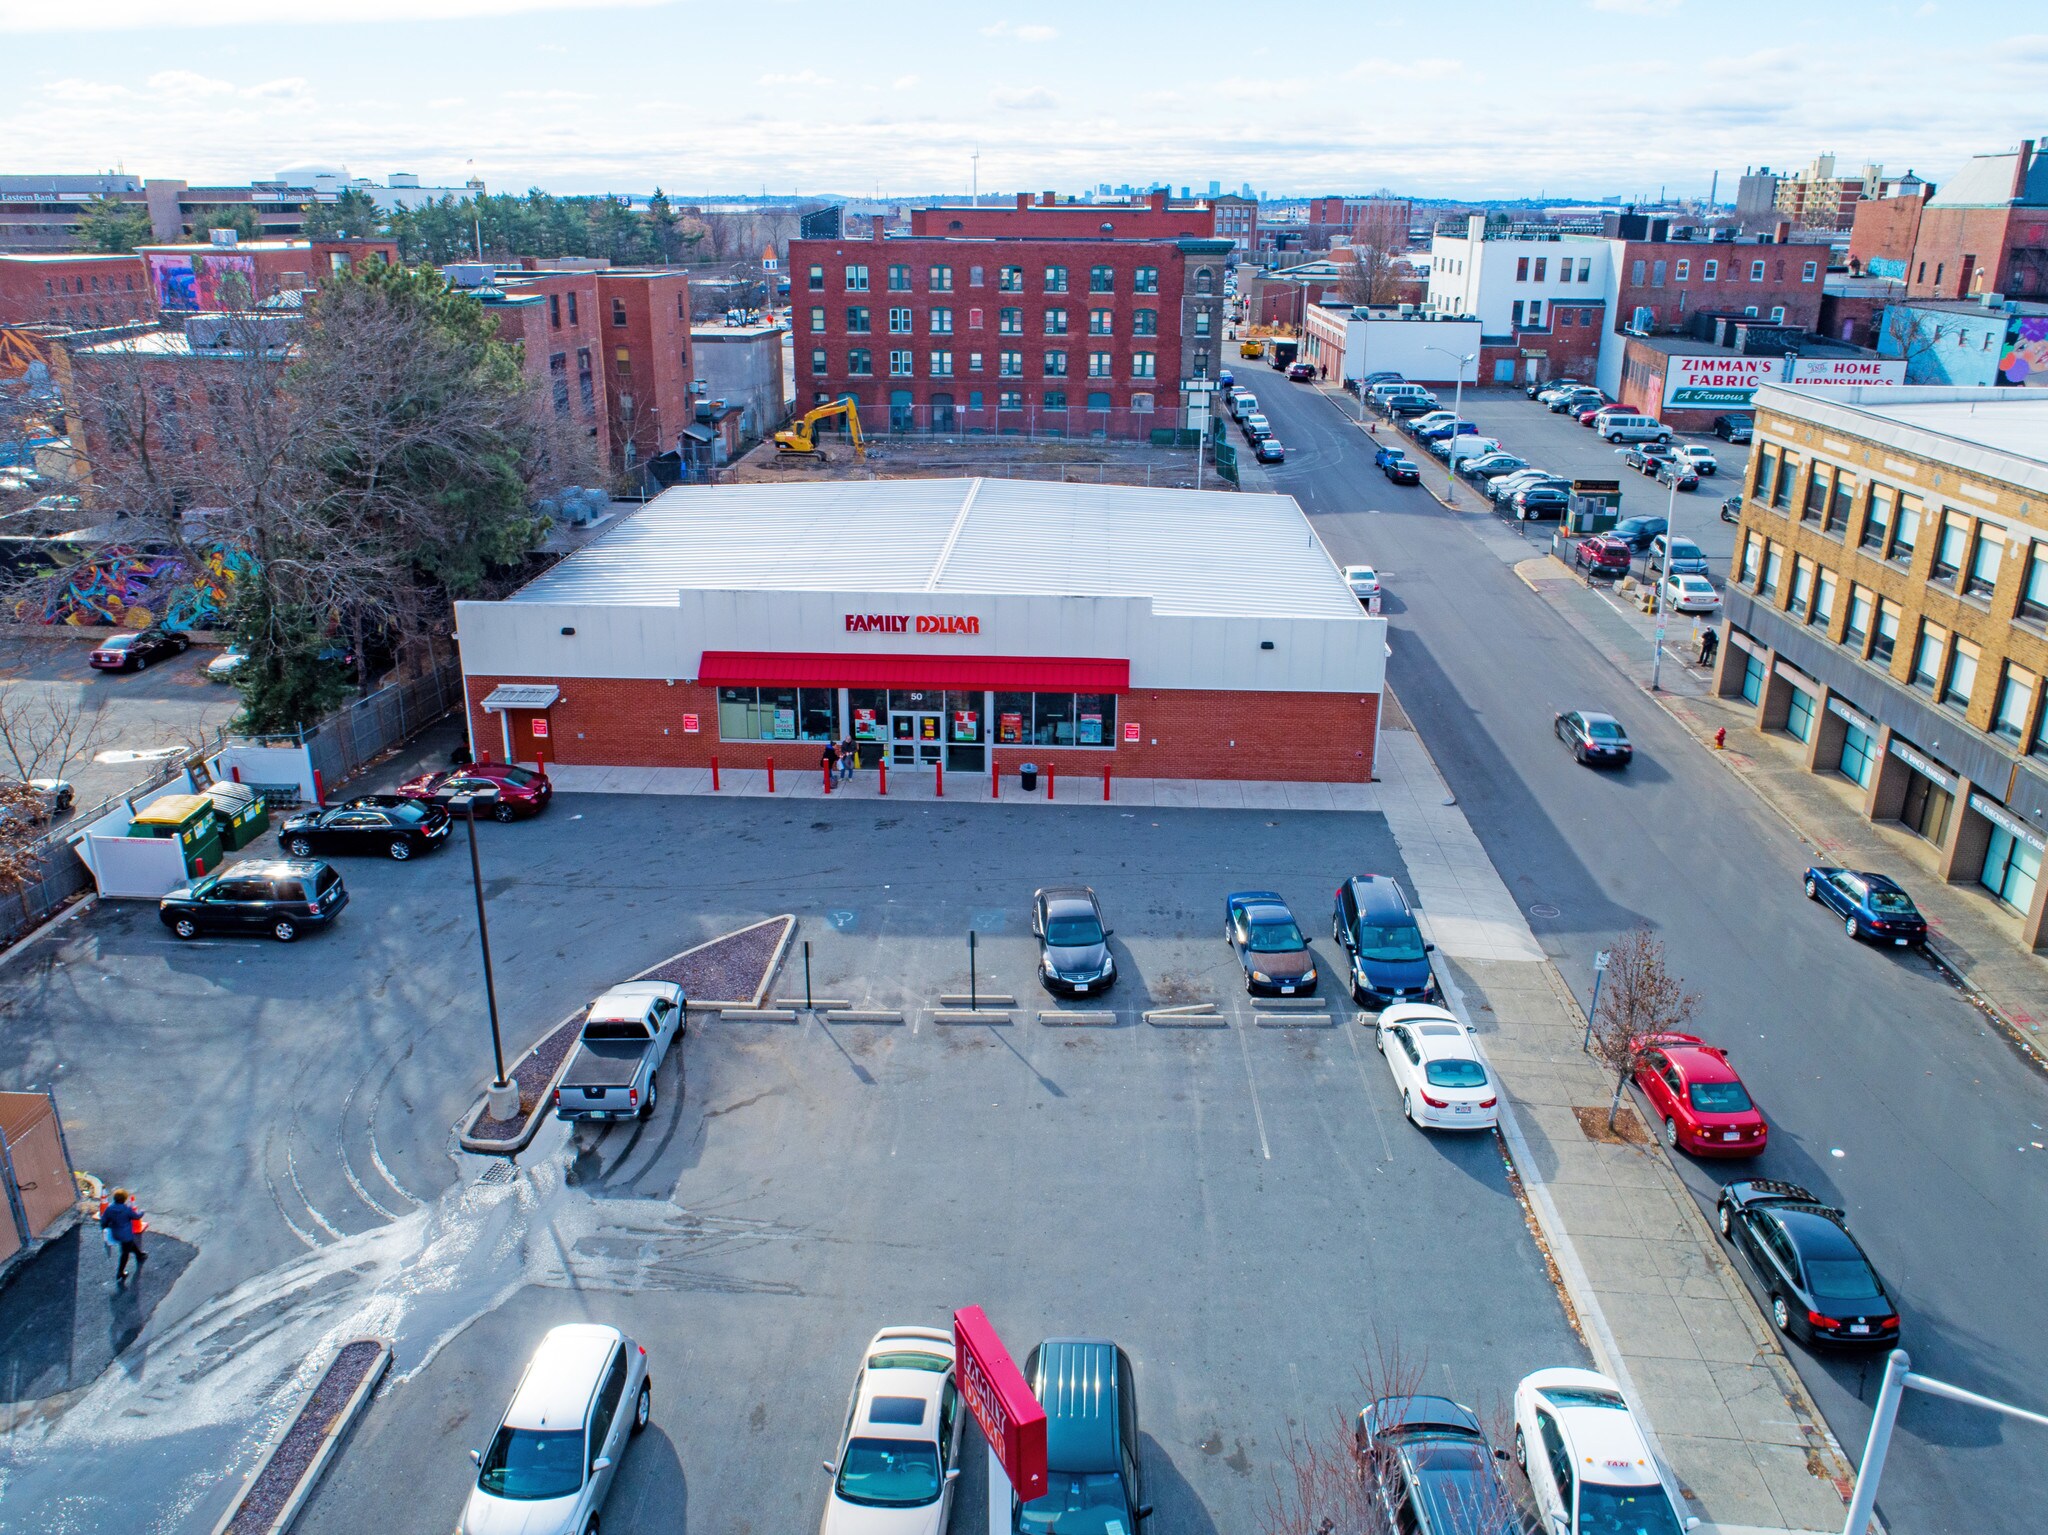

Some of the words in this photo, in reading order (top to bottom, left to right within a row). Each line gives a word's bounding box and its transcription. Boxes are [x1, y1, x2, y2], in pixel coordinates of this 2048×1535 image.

[2, 193, 33, 201] Eastern
[34, 193, 57, 201] Bank
[1681, 359, 1772, 373] ZIMMAN'S
[1833, 363, 1881, 374] HOME
[1689, 375, 1760, 387] FABRIC
[1677, 391, 1692, 399] A
[1694, 390, 1745, 401] Famous
[845, 614, 910, 633] FAMILY
[916, 615, 979, 634] DOLLAR
[1983, 805, 2011, 828] CHECKING
[2010, 823, 2027, 838] DEBIT
[963, 1345, 1007, 1435] FAMILY
[964, 1374, 1006, 1468] DOLLAR
